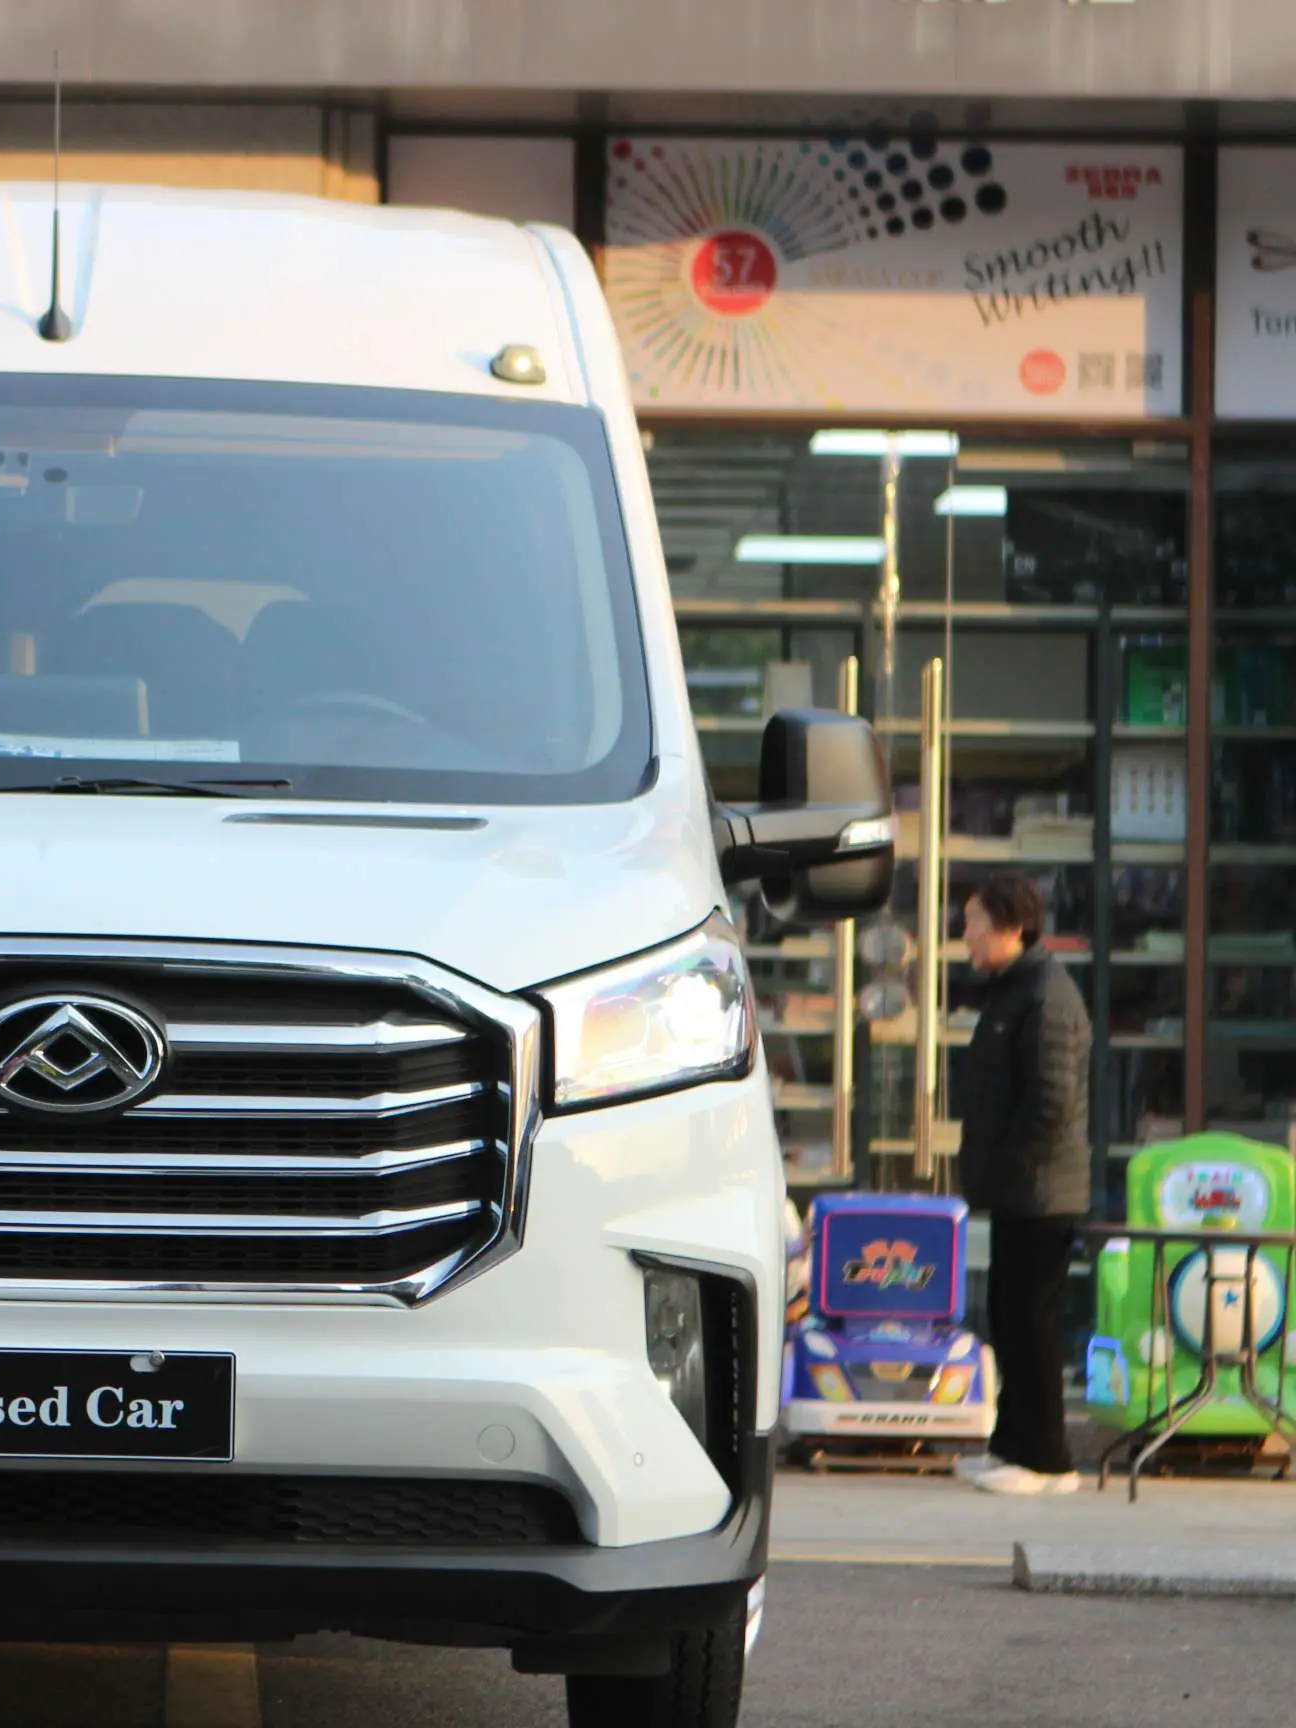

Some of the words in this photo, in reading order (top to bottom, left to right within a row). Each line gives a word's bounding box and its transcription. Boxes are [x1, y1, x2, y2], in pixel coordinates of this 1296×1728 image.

[713, 246, 756, 287] 57
[964, 212, 1131, 291] Smooth
[86, 1386, 185, 1429] Car
